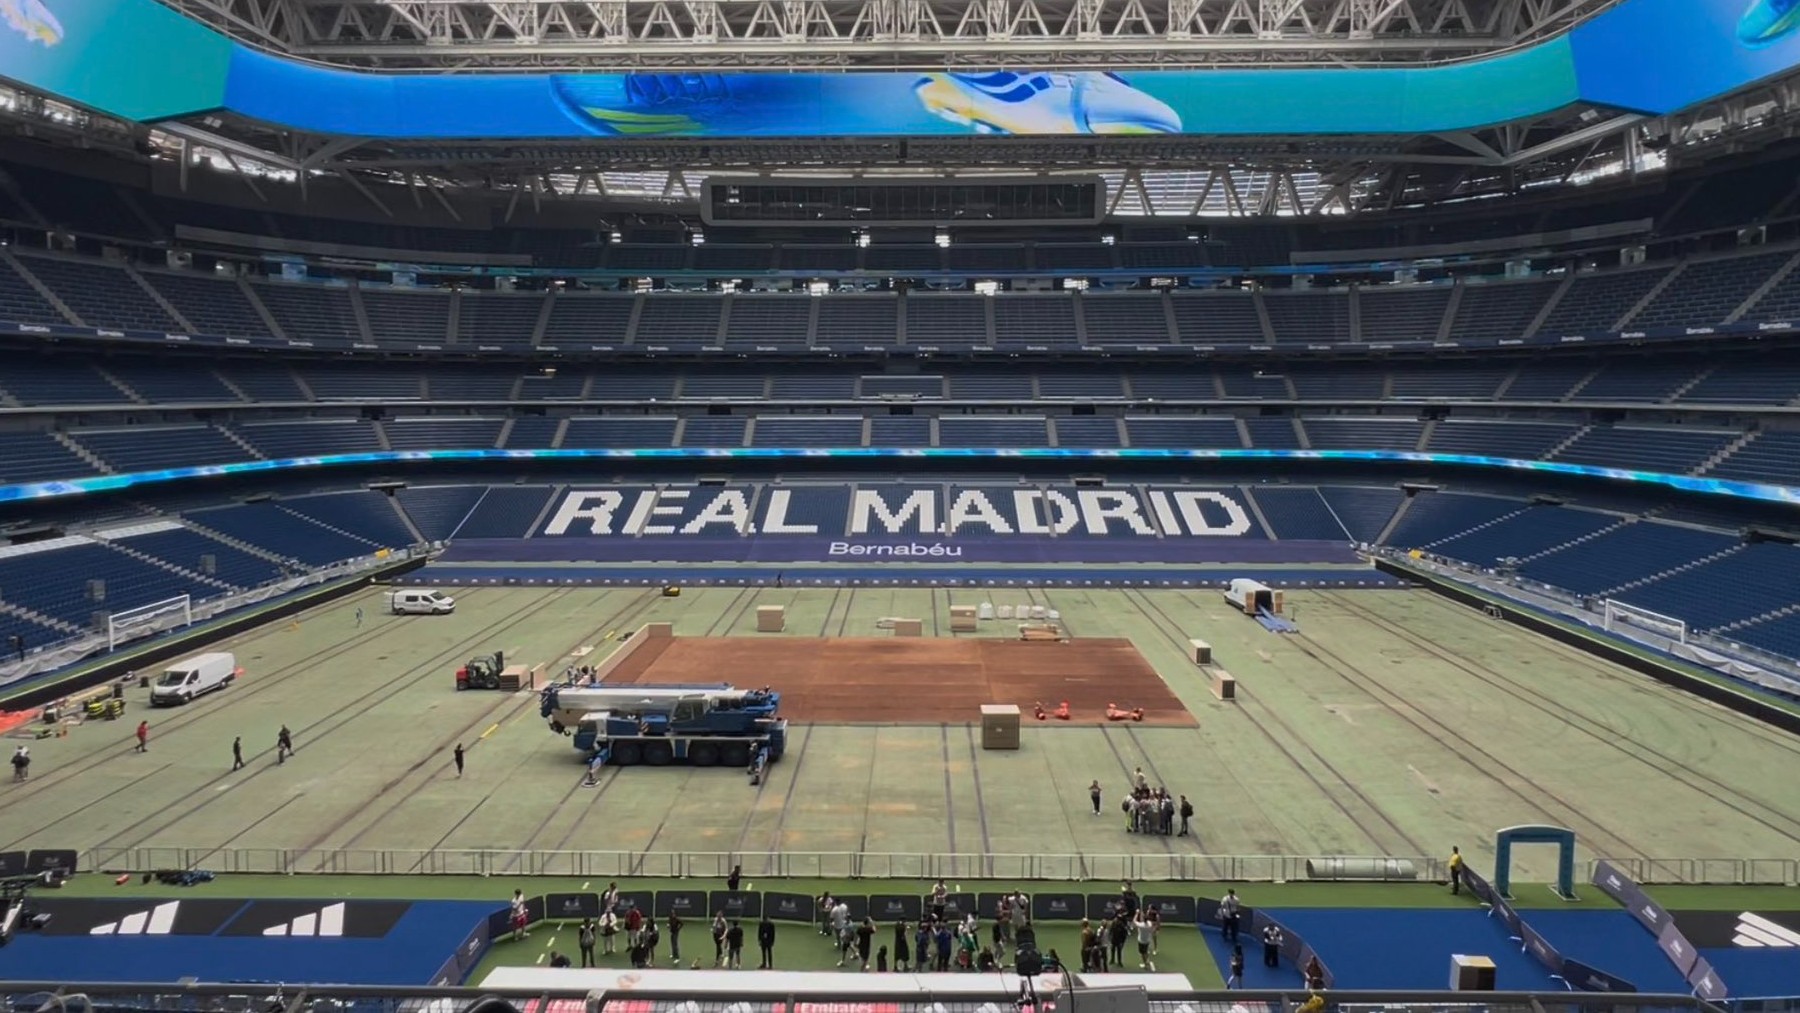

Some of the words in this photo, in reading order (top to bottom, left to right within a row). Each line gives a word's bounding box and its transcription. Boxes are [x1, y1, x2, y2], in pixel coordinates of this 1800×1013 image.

[544, 490, 818, 534] REAL
[851, 490, 1251, 535] MADRID
[829, 542, 962, 556] Bernabéu
